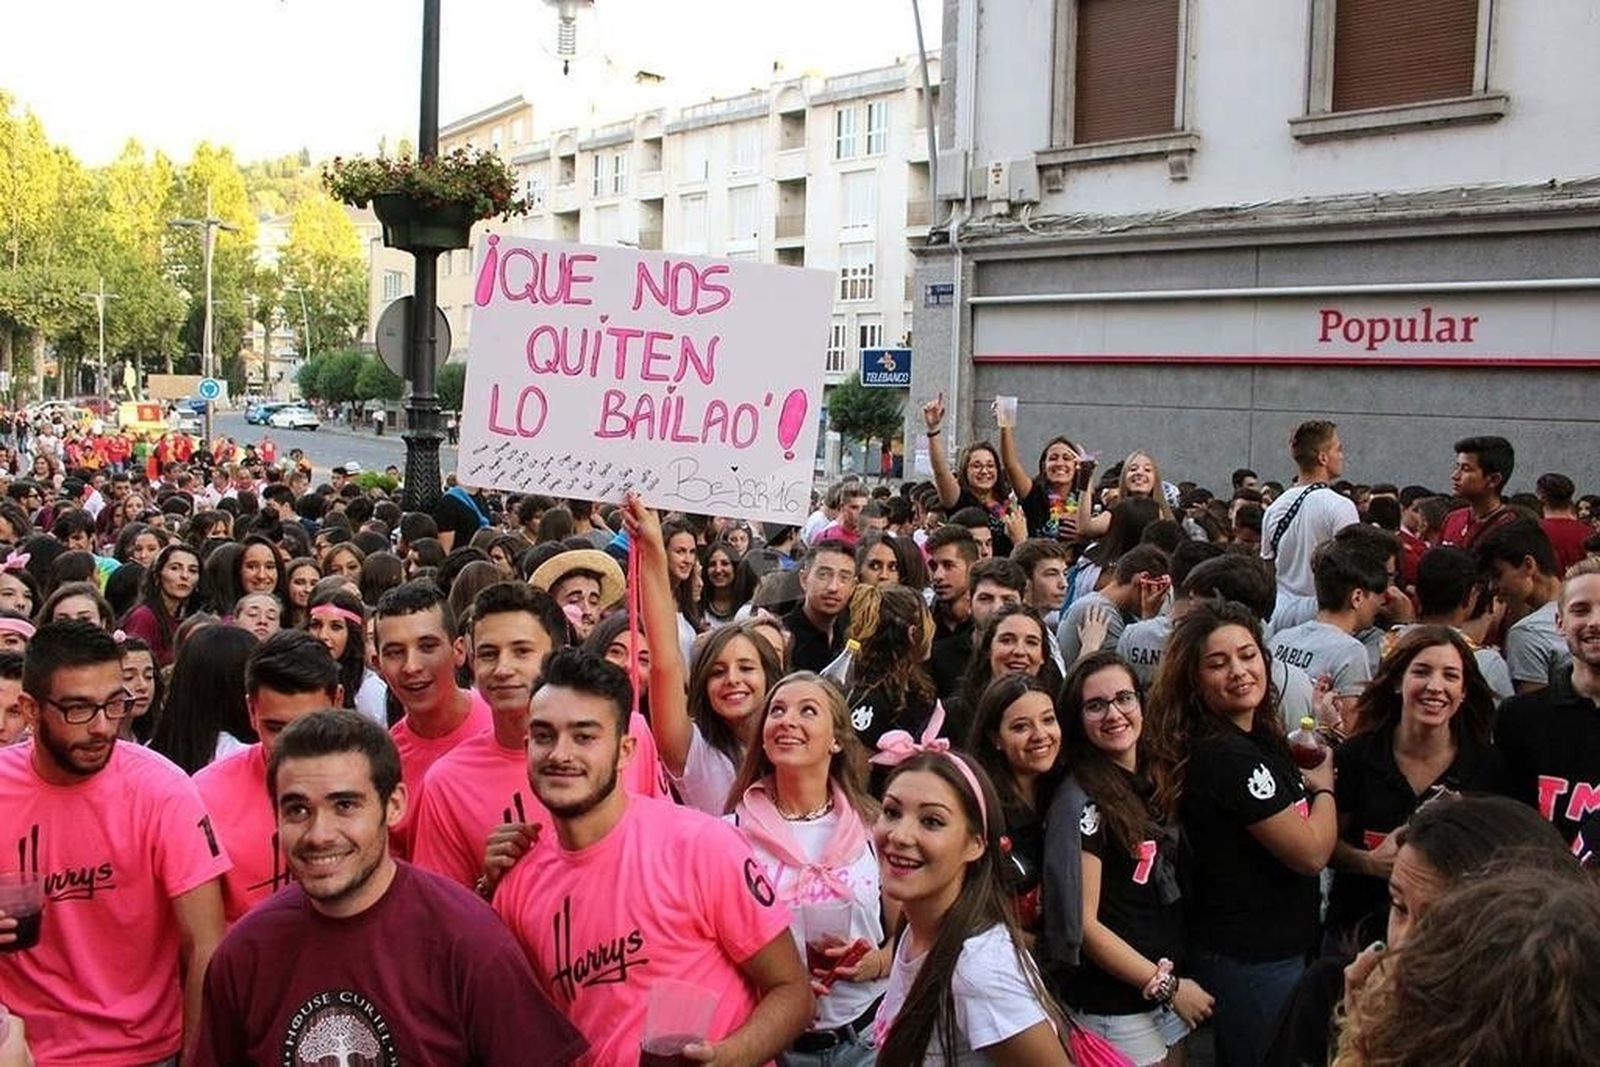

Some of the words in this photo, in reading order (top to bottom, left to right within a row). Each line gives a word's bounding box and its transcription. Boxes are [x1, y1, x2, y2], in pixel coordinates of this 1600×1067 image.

[631, 260, 732, 317] NOS
[1317, 306, 1480, 351] Popular
[866, 371, 910, 383] TELEBANCO
[487, 384, 549, 439] LO
[1273, 643, 1314, 669] PABLO
[197, 814, 220, 858] 1
[743, 857, 776, 908] 6
[551, 895, 650, 1006] Harrys
[285, 992, 331, 1046] HOUSE
[339, 991, 391, 1046] CURIEL
